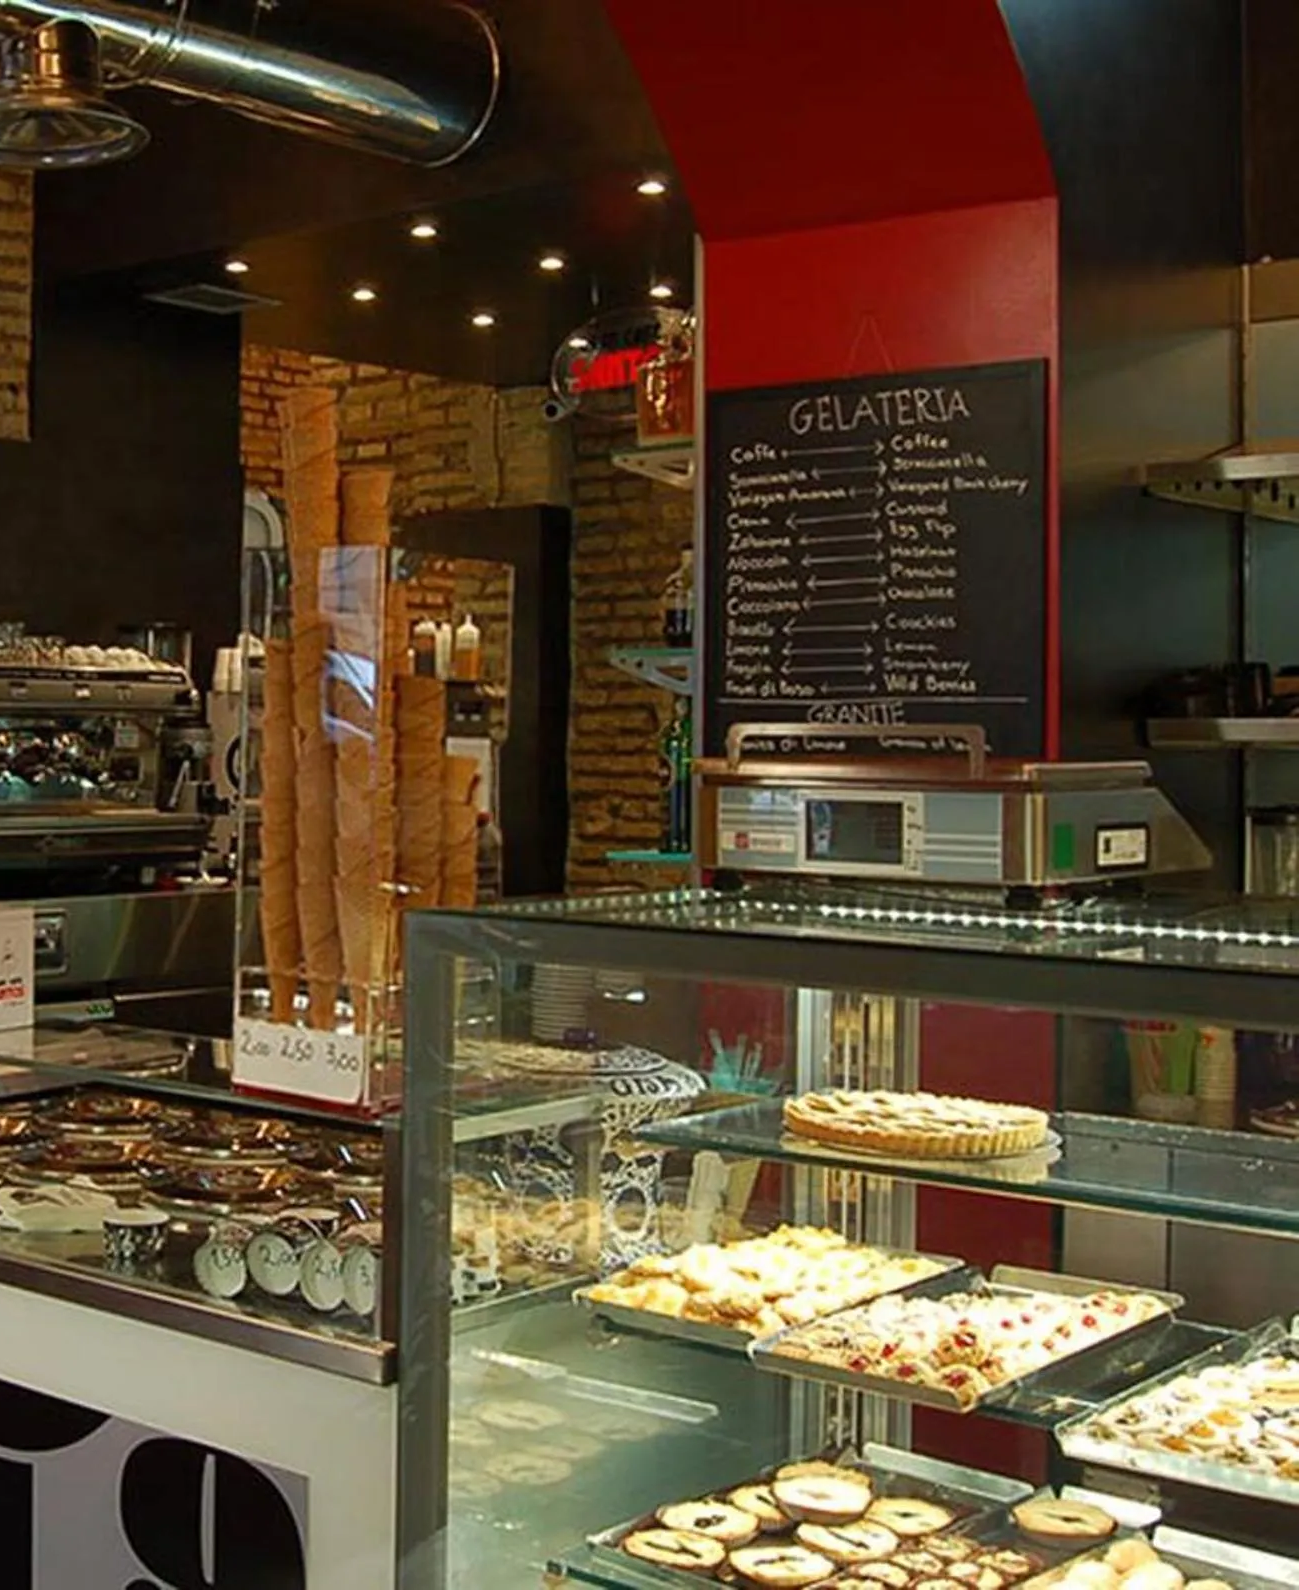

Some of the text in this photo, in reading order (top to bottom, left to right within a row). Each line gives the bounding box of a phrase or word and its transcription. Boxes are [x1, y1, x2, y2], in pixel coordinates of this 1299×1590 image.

[790, 387, 972, 434] GELATERIA
[891, 432, 949, 452] Coffee
[806, 701, 907, 726] GRANITE
